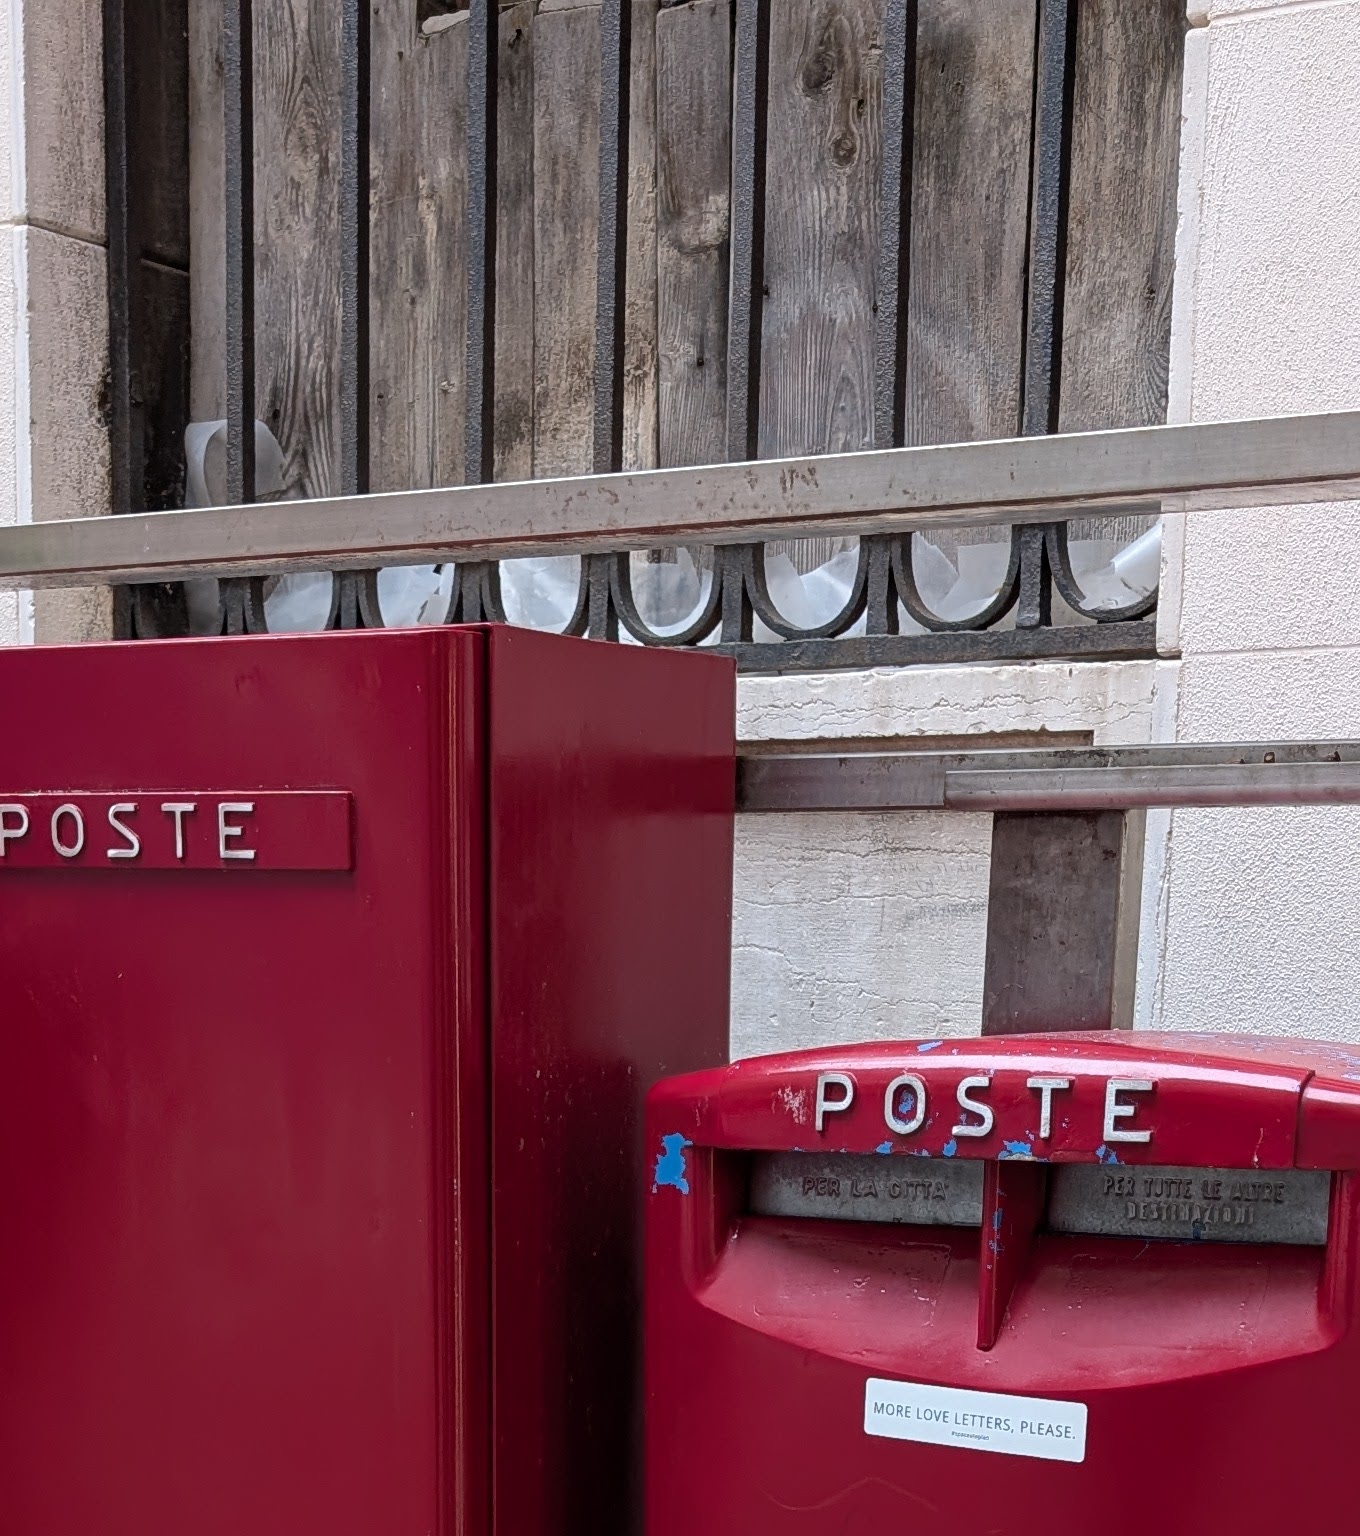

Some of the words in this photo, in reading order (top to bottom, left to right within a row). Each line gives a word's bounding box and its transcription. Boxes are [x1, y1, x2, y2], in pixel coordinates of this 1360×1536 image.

[814, 1072, 1155, 1144] POSTE
[802, 1176, 840, 1197] PER
[851, 1177, 878, 1198] LA
[1103, 1175, 1135, 1197] PER
[1144, 1177, 1192, 1199] TUTTE
[1202, 1179, 1222, 1200] LE
[1230, 1180, 1285, 1203] ALTRE
[873, 1401, 911, 1418] MORE
[916, 1407, 949, 1424] LOVE
[954, 1412, 1015, 1434] LETTERS,
[1020, 1420, 1076, 1440] PLEASE.
